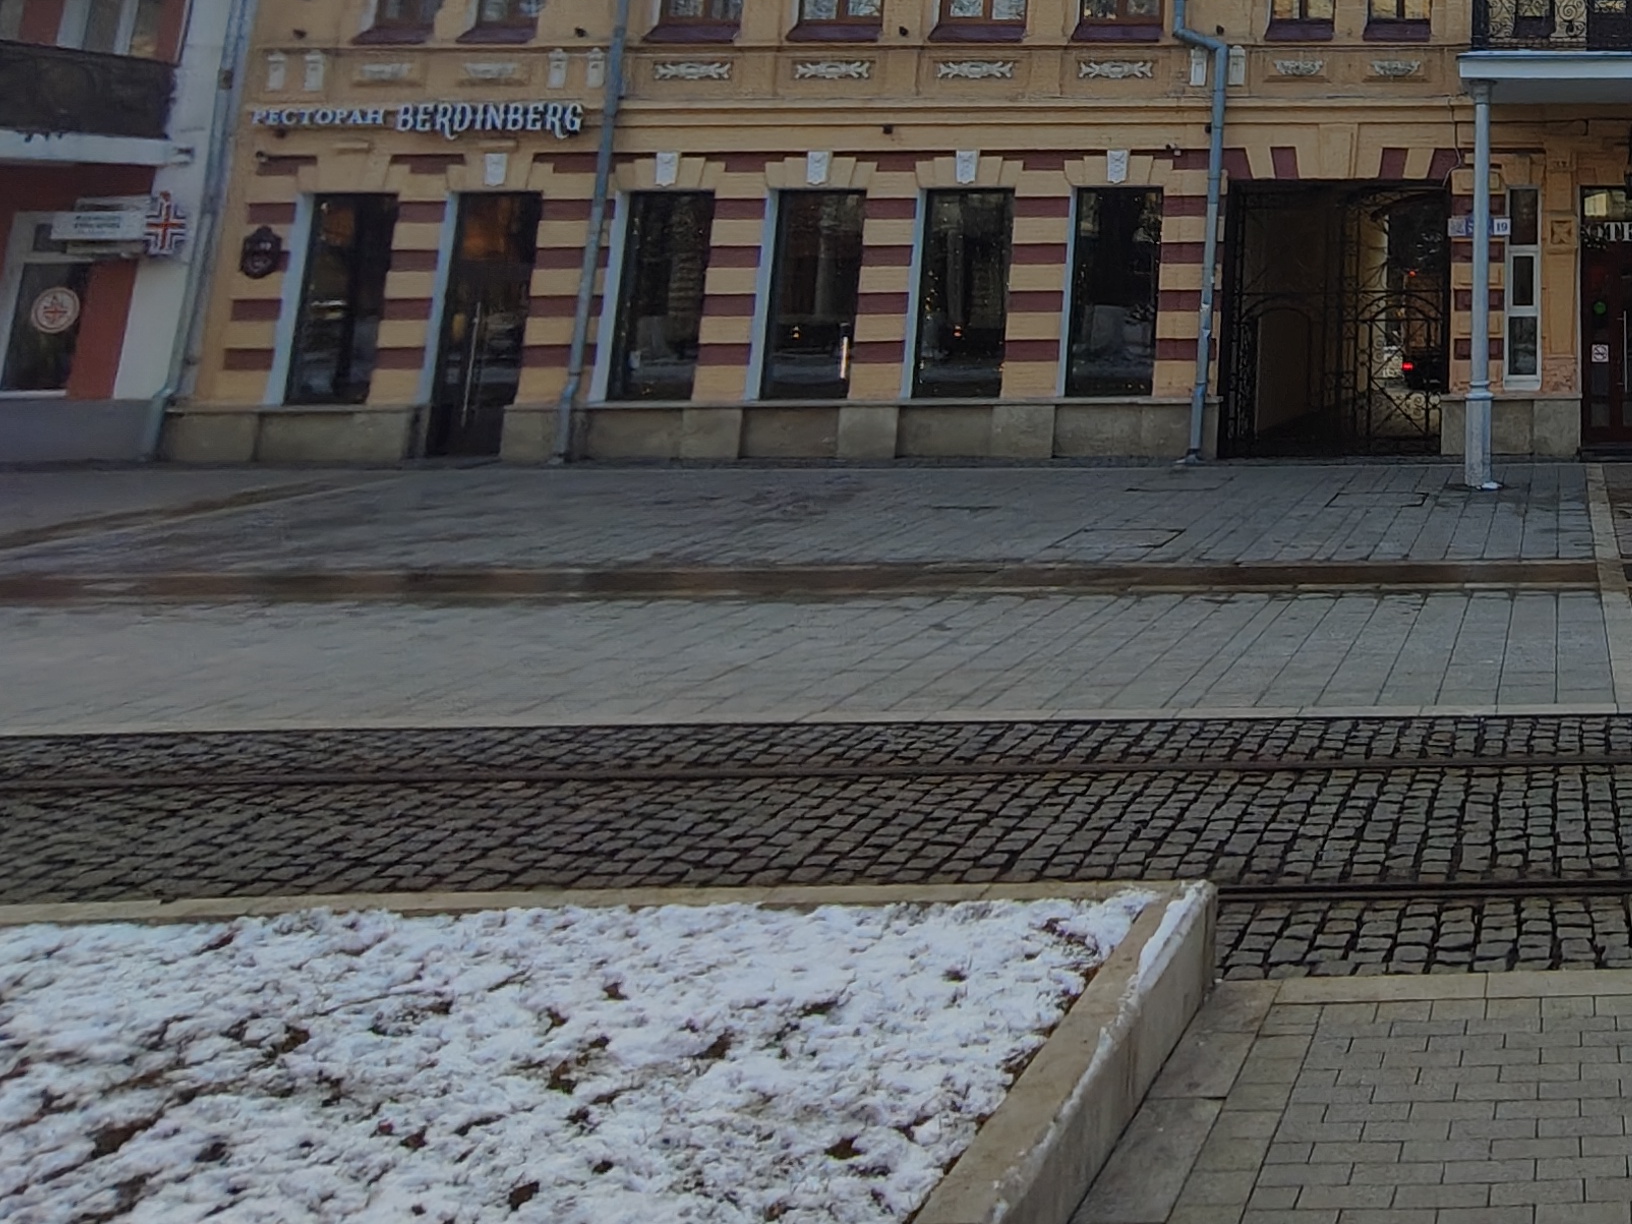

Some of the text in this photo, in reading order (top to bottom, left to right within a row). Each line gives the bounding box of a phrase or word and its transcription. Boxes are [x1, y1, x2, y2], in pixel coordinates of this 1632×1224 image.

[251, 102, 584, 140] РЕСТОРАН BERDINBERG
[1496, 222, 1508, 232] 19
